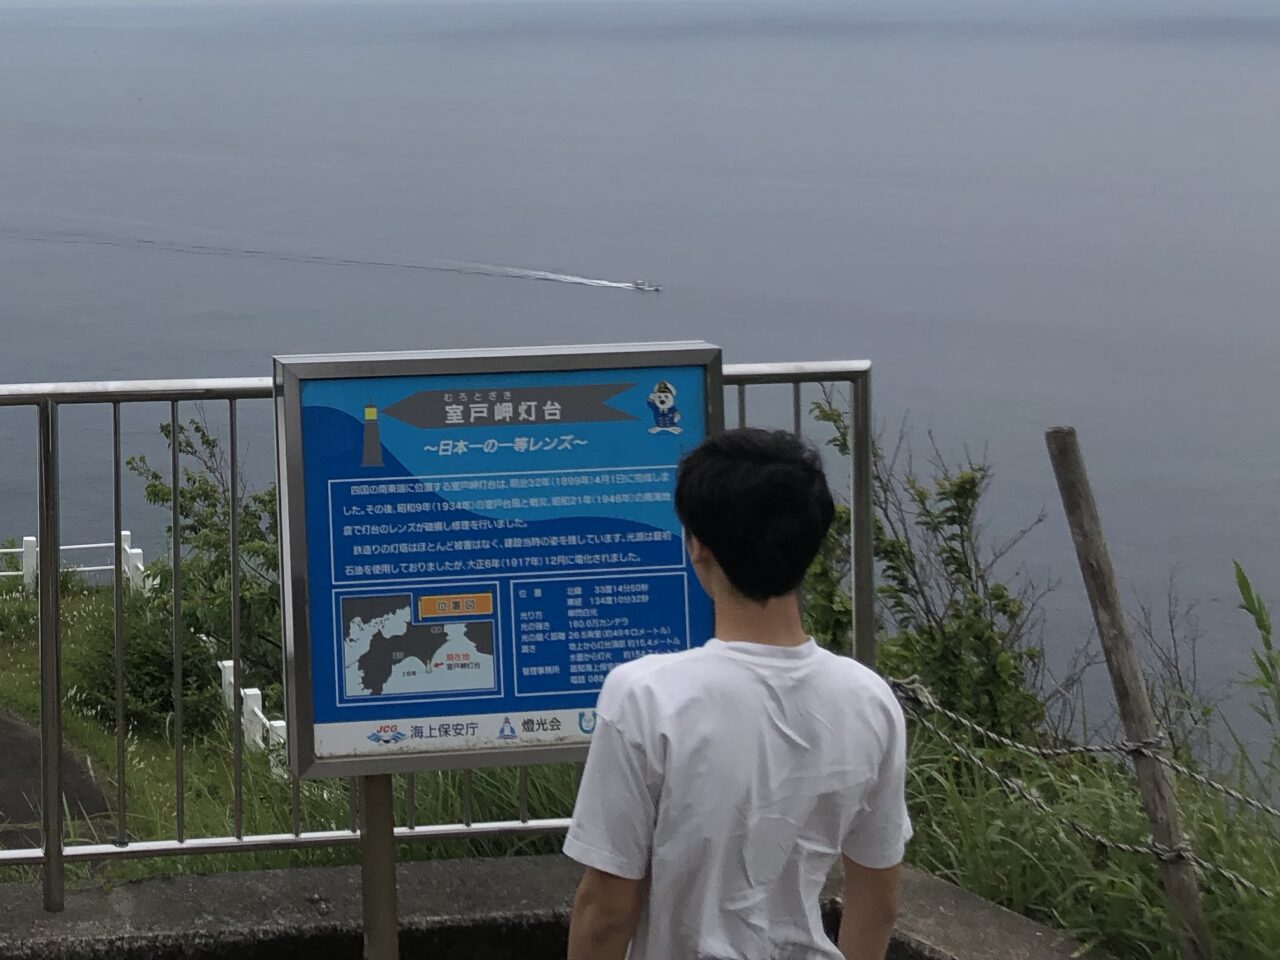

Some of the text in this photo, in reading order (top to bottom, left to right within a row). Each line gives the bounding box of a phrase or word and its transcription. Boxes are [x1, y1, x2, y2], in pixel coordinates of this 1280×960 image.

[443, 392, 512, 402] むろとざき
[444, 400, 562, 424] 室戸岬灯台
[376, 724, 398, 734] JCG
[410, 722, 479, 740] 海上保安庁
[521, 717, 562, 733] 燈光会
